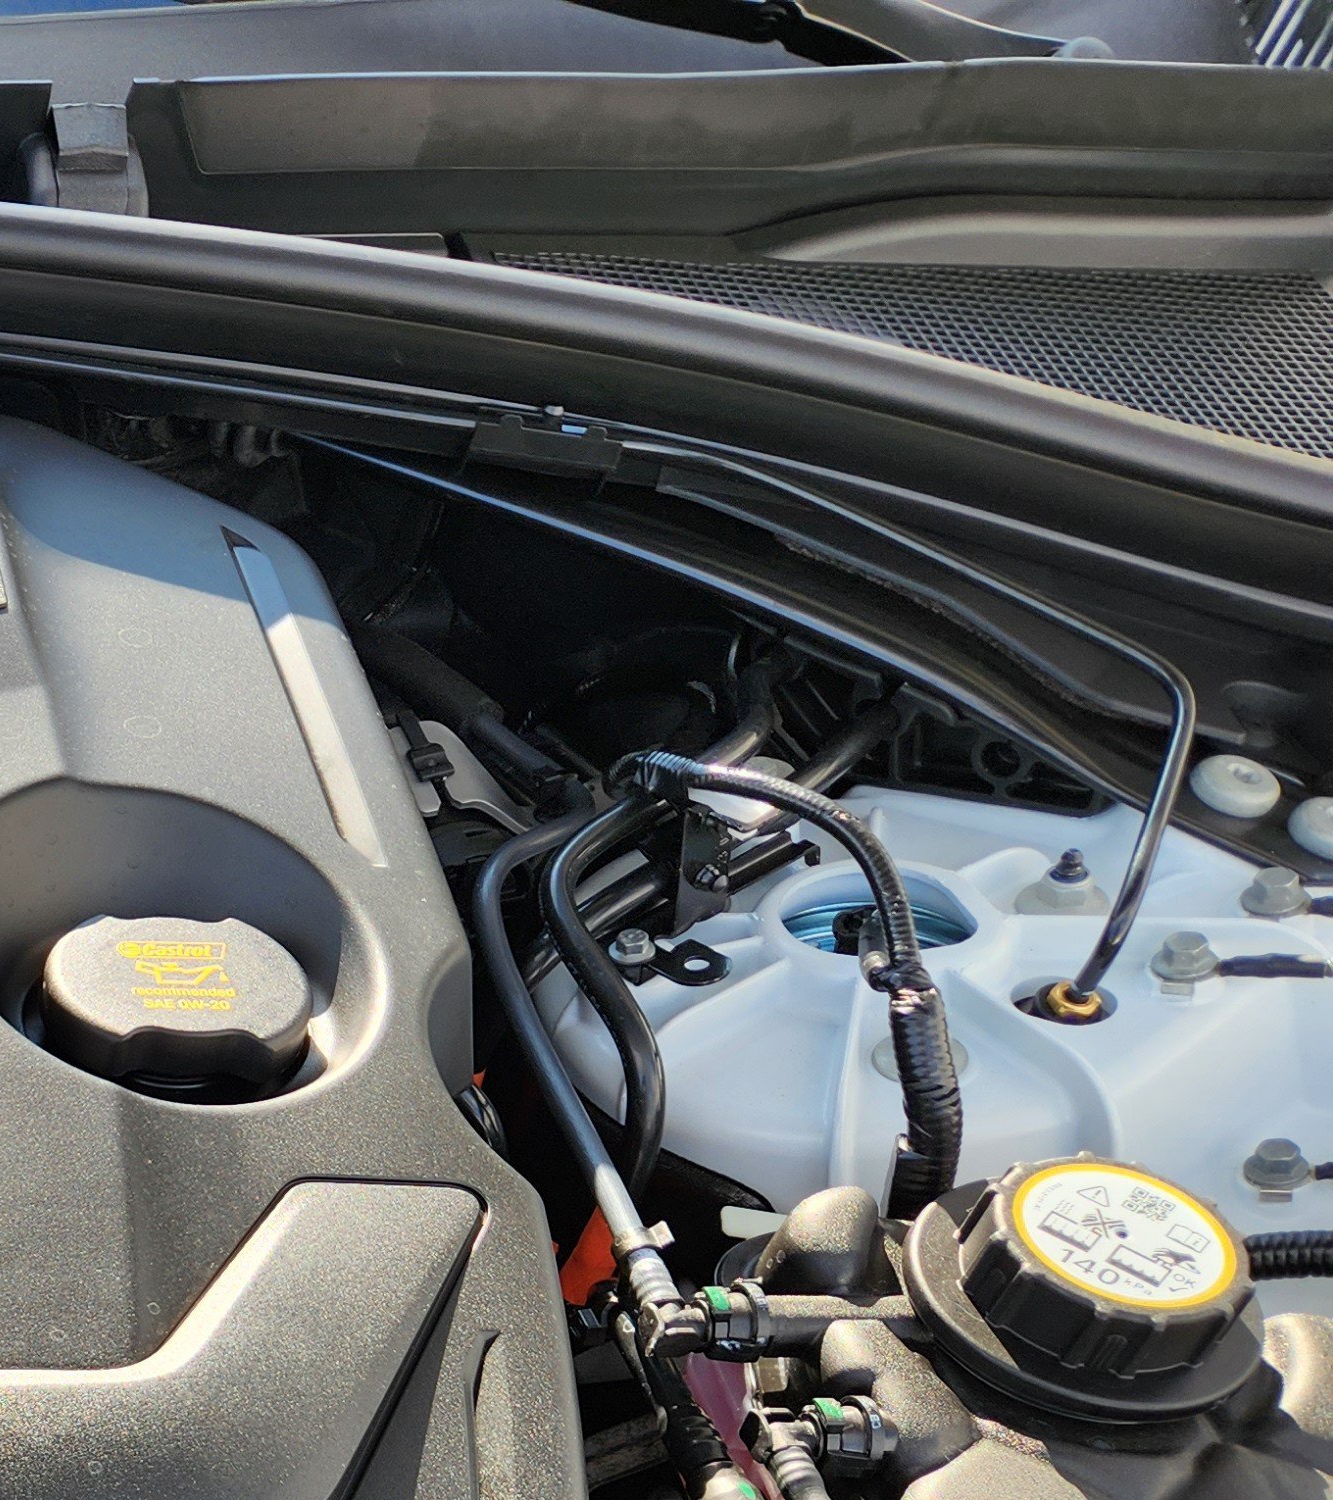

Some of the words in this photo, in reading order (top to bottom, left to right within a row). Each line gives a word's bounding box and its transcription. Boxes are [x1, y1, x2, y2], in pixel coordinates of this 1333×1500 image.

[141, 942, 212, 958] Castrol
[132, 986, 235, 998] recommended
[143, 998, 175, 1010] SAE
[1059, 1248, 1121, 1285] 140
[1123, 1277, 1153, 1296] kPa
[1173, 1271, 1198, 1289] OK
